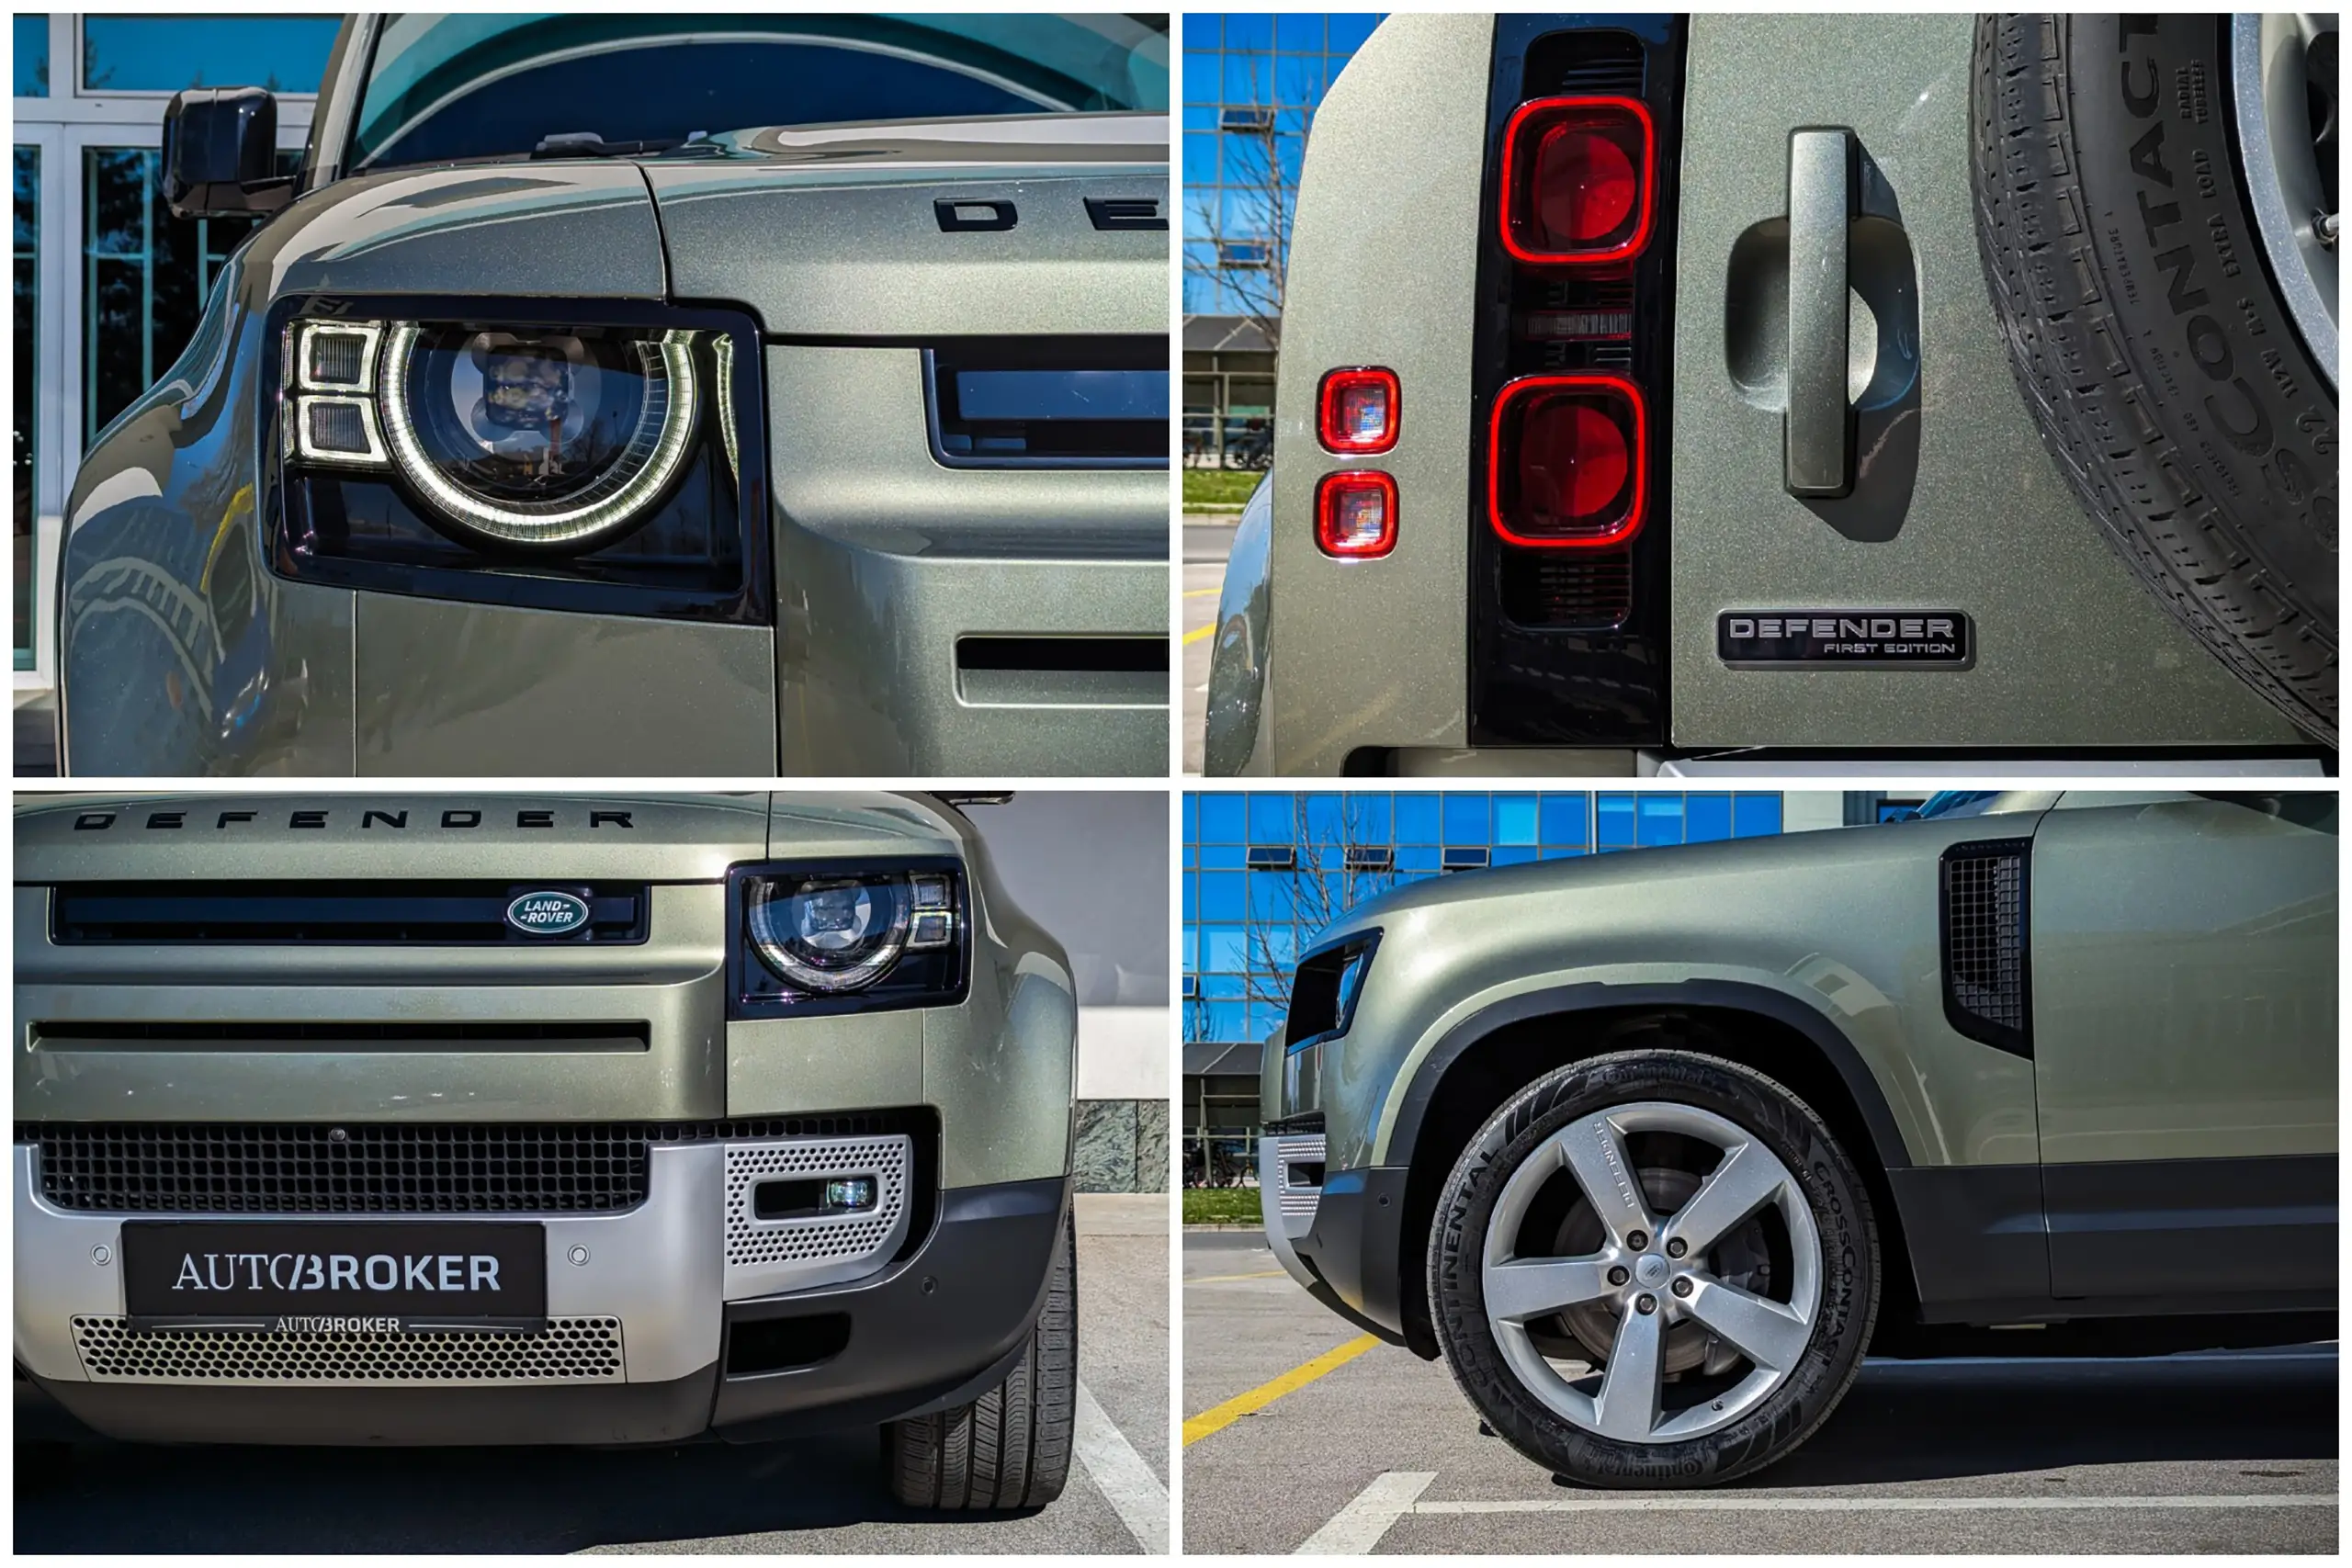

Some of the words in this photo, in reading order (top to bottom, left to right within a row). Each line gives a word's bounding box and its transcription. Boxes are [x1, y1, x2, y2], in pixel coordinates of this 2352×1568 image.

[2176, 67, 2192, 119] RADIAL
[2192, 149, 2216, 199] LOAD
[2109, 228, 2141, 304] TEMPERATURE
[2208, 212, 2241, 279] EXTRA
[1729, 619, 1954, 638] DEFENDER
[1824, 643, 1878, 653] FIRST
[1883, 643, 1955, 653] EDITION
[74, 809, 634, 830] DEFENDER
[524, 900, 561, 911] LAND
[526, 912, 573, 923] ROVER
[1594, 1122, 1634, 1207] DEFENDER
[1443, 1147, 1499, 1386] CONTINENTAL
